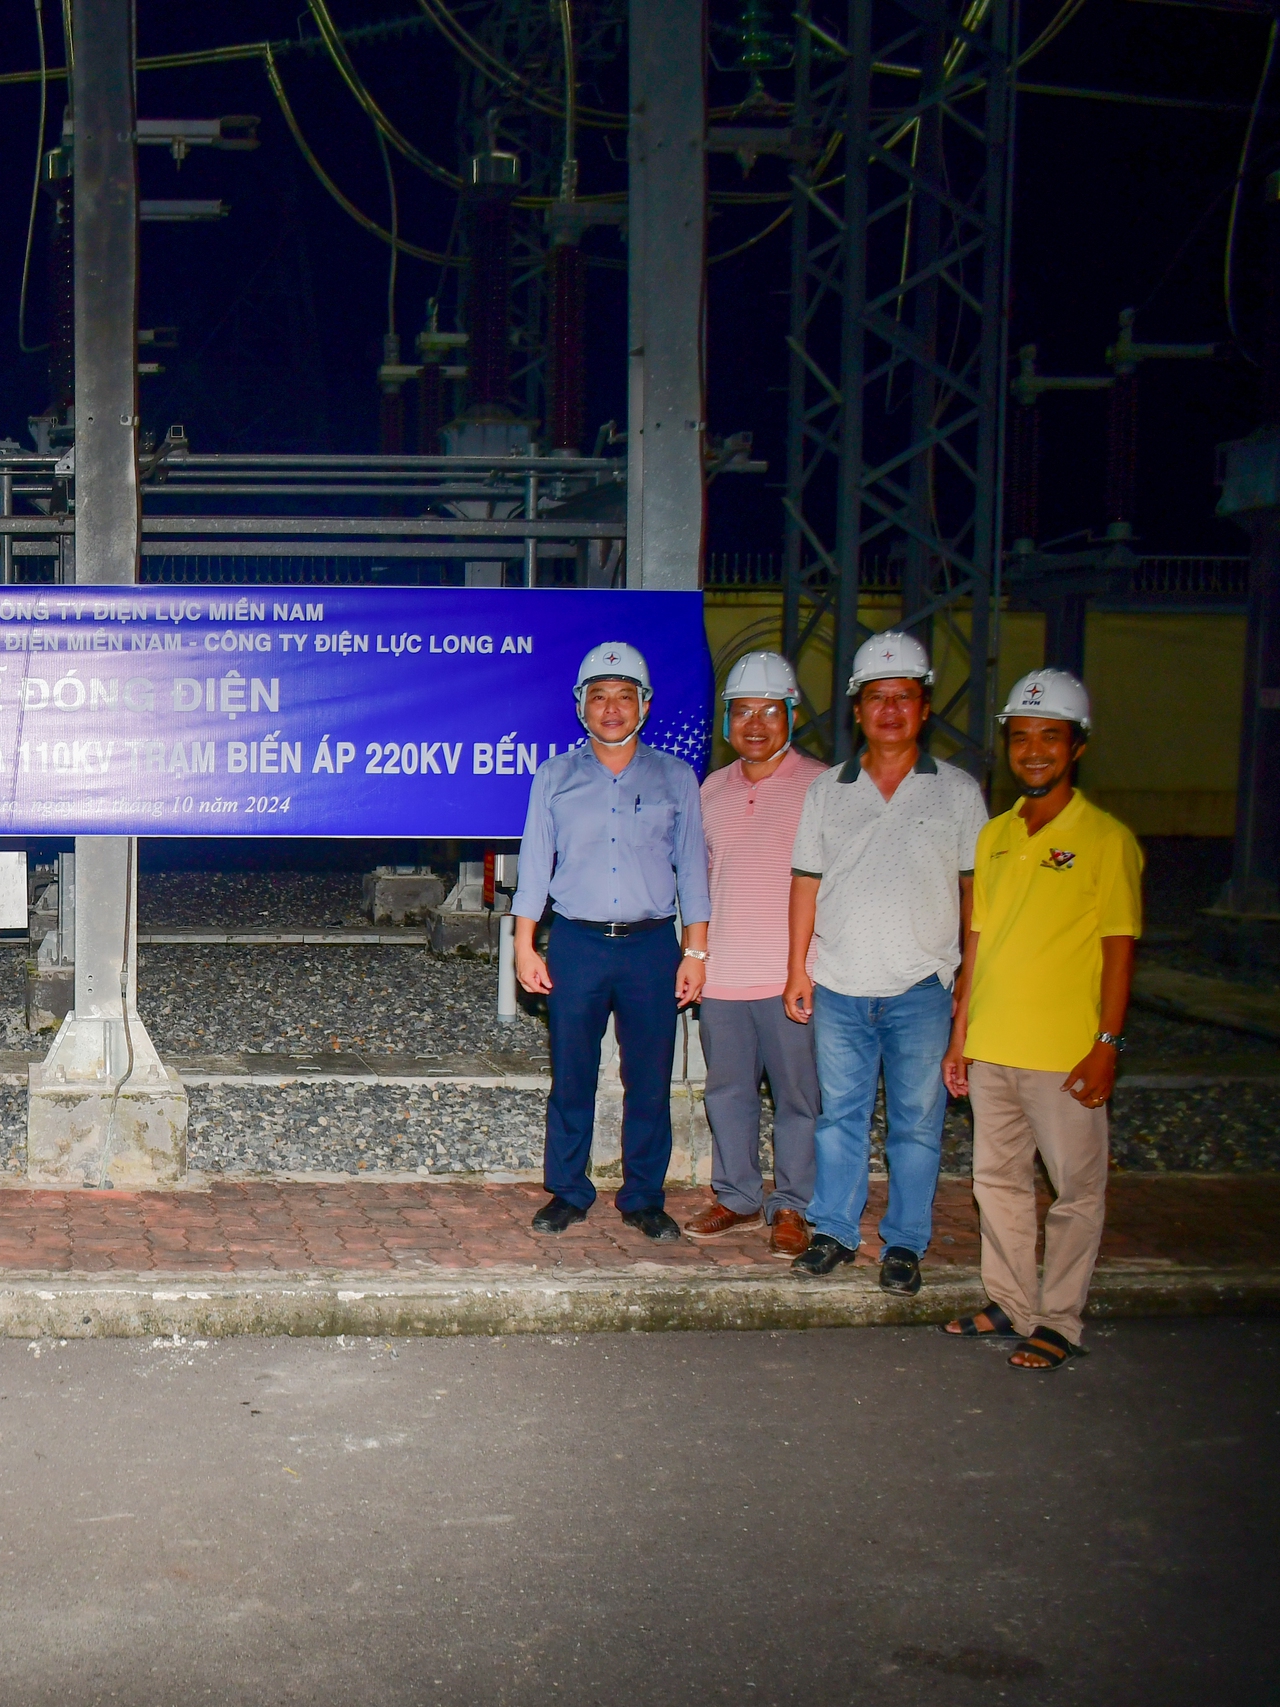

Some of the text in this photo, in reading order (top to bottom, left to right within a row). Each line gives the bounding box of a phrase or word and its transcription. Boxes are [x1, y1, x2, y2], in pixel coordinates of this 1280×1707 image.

[57, 602, 91, 621] TY
[93, 598, 147, 624] ĐIỆN
[155, 600, 202, 624] LỰC
[209, 597, 265, 621] MIỀN
[273, 603, 325, 621] NAM
[4, 629, 59, 654] ĐIỆN
[67, 627, 123, 652] MIỀN
[131, 633, 182, 652] NAM
[204, 629, 272, 653] CÔNG
[278, 633, 309, 652] TY
[314, 630, 369, 656] ĐIỆN
[376, 632, 422, 657] LỰC
[429, 635, 493, 654] LONG
[500, 636, 533, 654] AN
[18, 669, 155, 713] ĐÓNG
[171, 669, 279, 720] ĐIỆN
[18, 740, 115, 774] 110KV
[124, 741, 216, 779] TRẠM
[227, 730, 302, 774] BIẾN
[311, 734, 356, 774] ÁP
[365, 742, 463, 775] 220KV
[473, 732, 537, 775] BẾN
[31, 797, 76, 817] ngày
[112, 796, 165, 817] tháng
[172, 796, 194, 813] 10
[199, 797, 238, 813] năm
[245, 796, 291, 813] 2024
